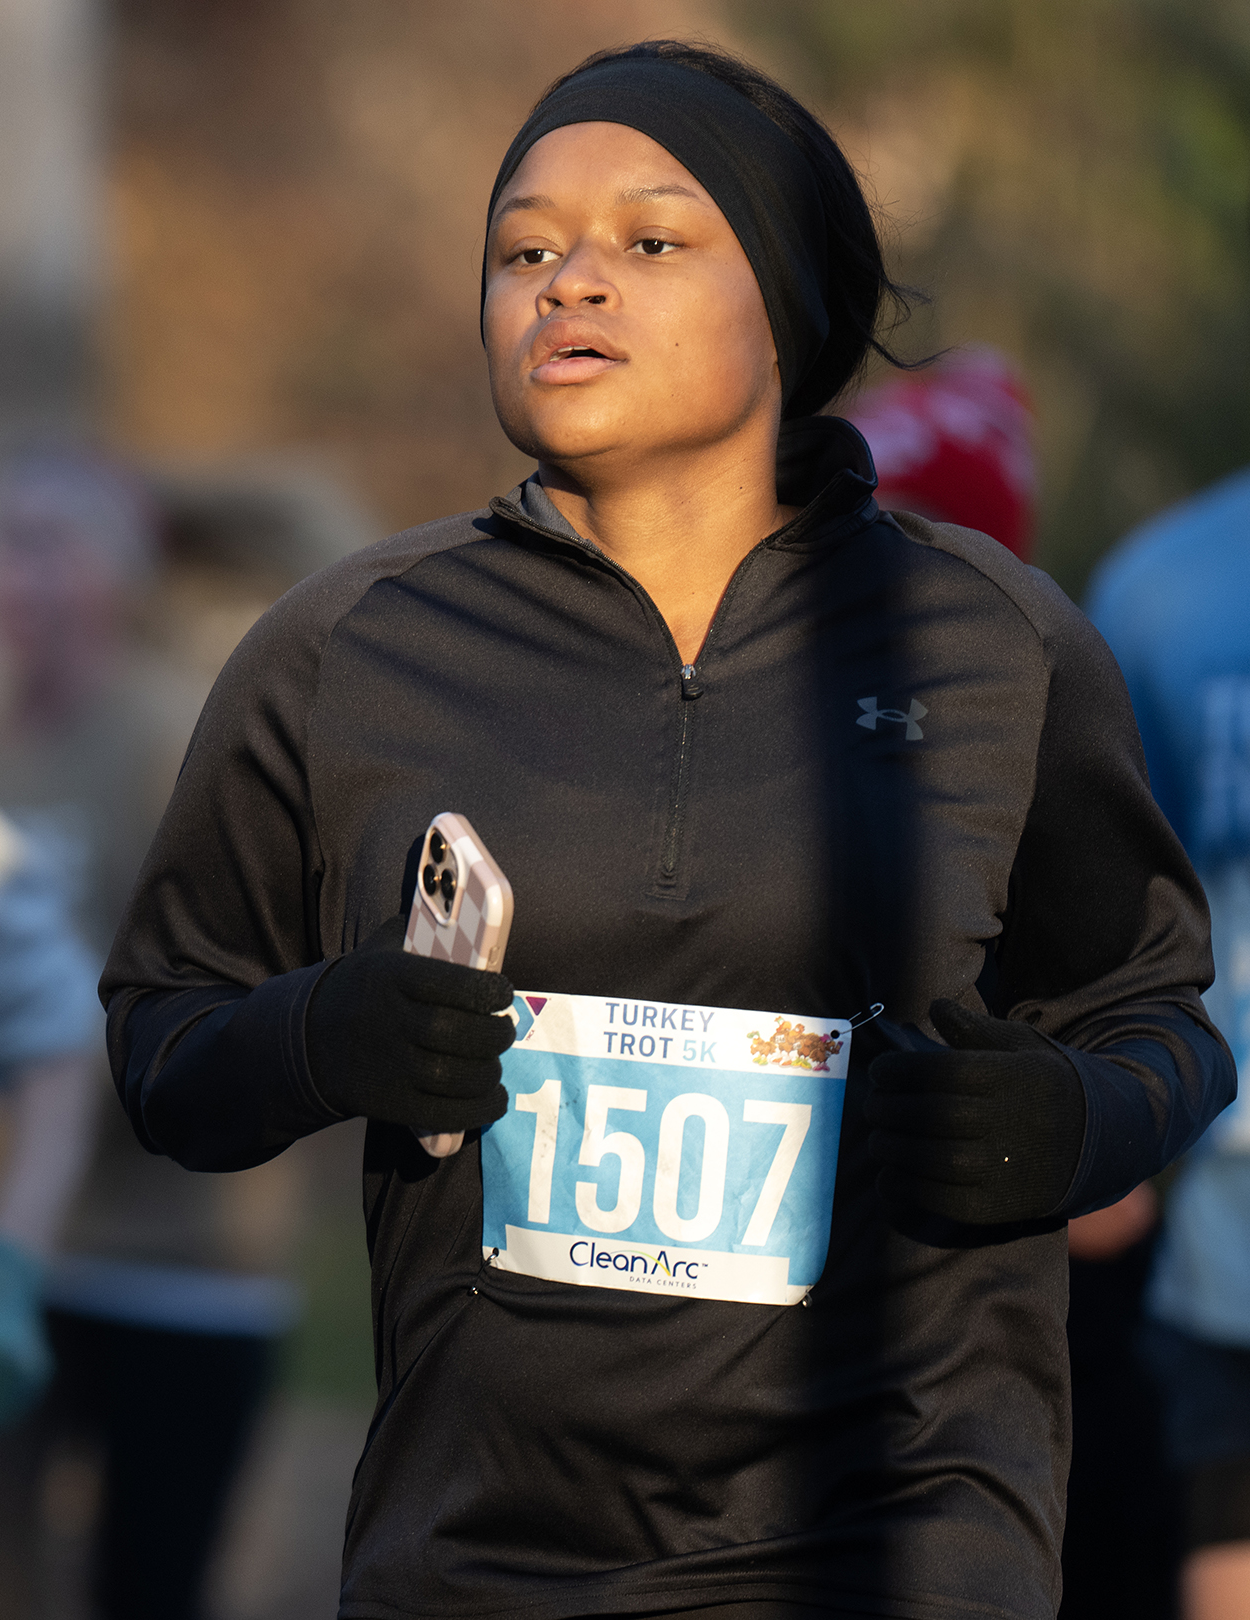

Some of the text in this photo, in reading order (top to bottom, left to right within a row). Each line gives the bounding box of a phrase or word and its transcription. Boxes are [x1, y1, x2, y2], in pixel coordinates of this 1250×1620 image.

[605, 1002, 715, 1033] TURKEY
[603, 1031, 717, 1064] TROT 5K
[515, 1078, 812, 1247] 1507
[629, 1276, 698, 1290] DATA CENTERS
